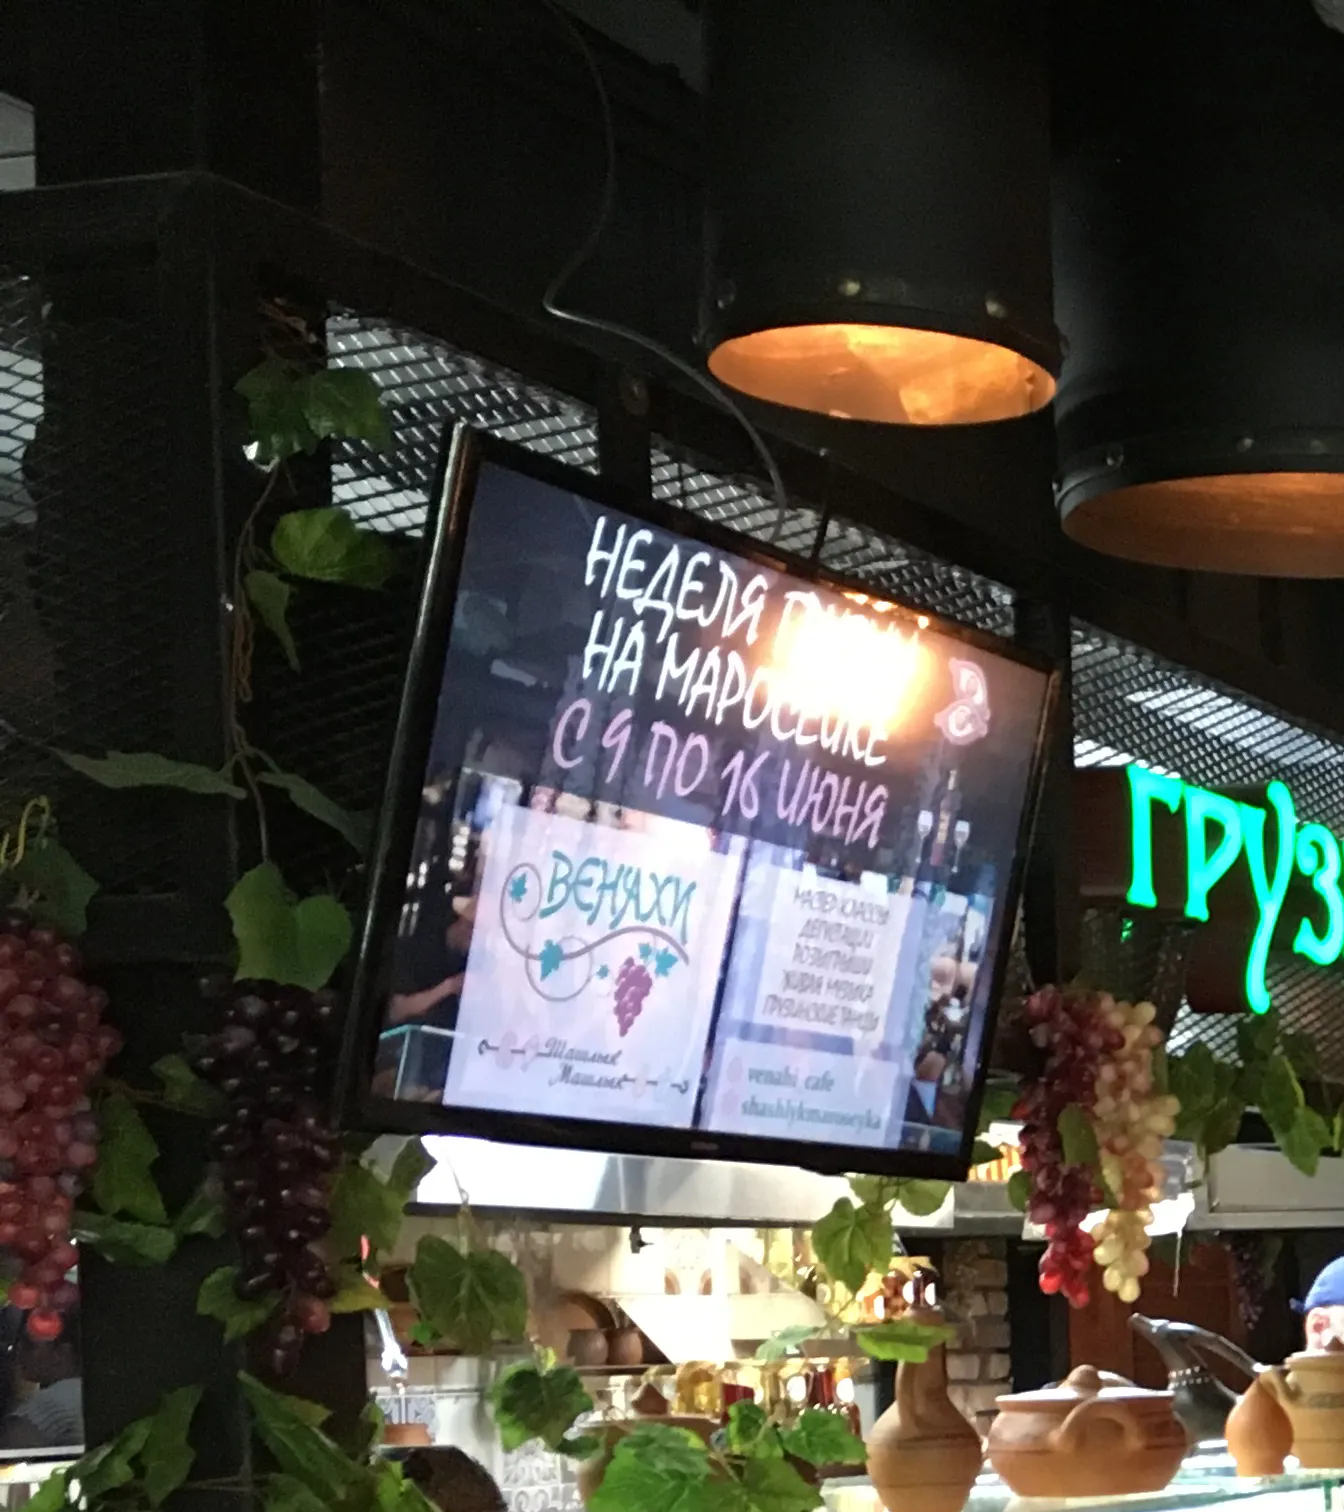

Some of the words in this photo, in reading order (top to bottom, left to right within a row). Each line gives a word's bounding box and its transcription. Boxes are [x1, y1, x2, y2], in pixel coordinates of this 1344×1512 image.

[585, 516, 768, 645] НЕДЕЛЯ
[582, 611, 648, 696] НА
[553, 699, 590, 769] С
[602, 708, 633, 784] 9
[643, 721, 709, 799] ПО
[721, 751, 770, 819] 16
[776, 759, 889, 849] ИЮНЯ
[538, 850, 697, 944] ВЕНАХИ
